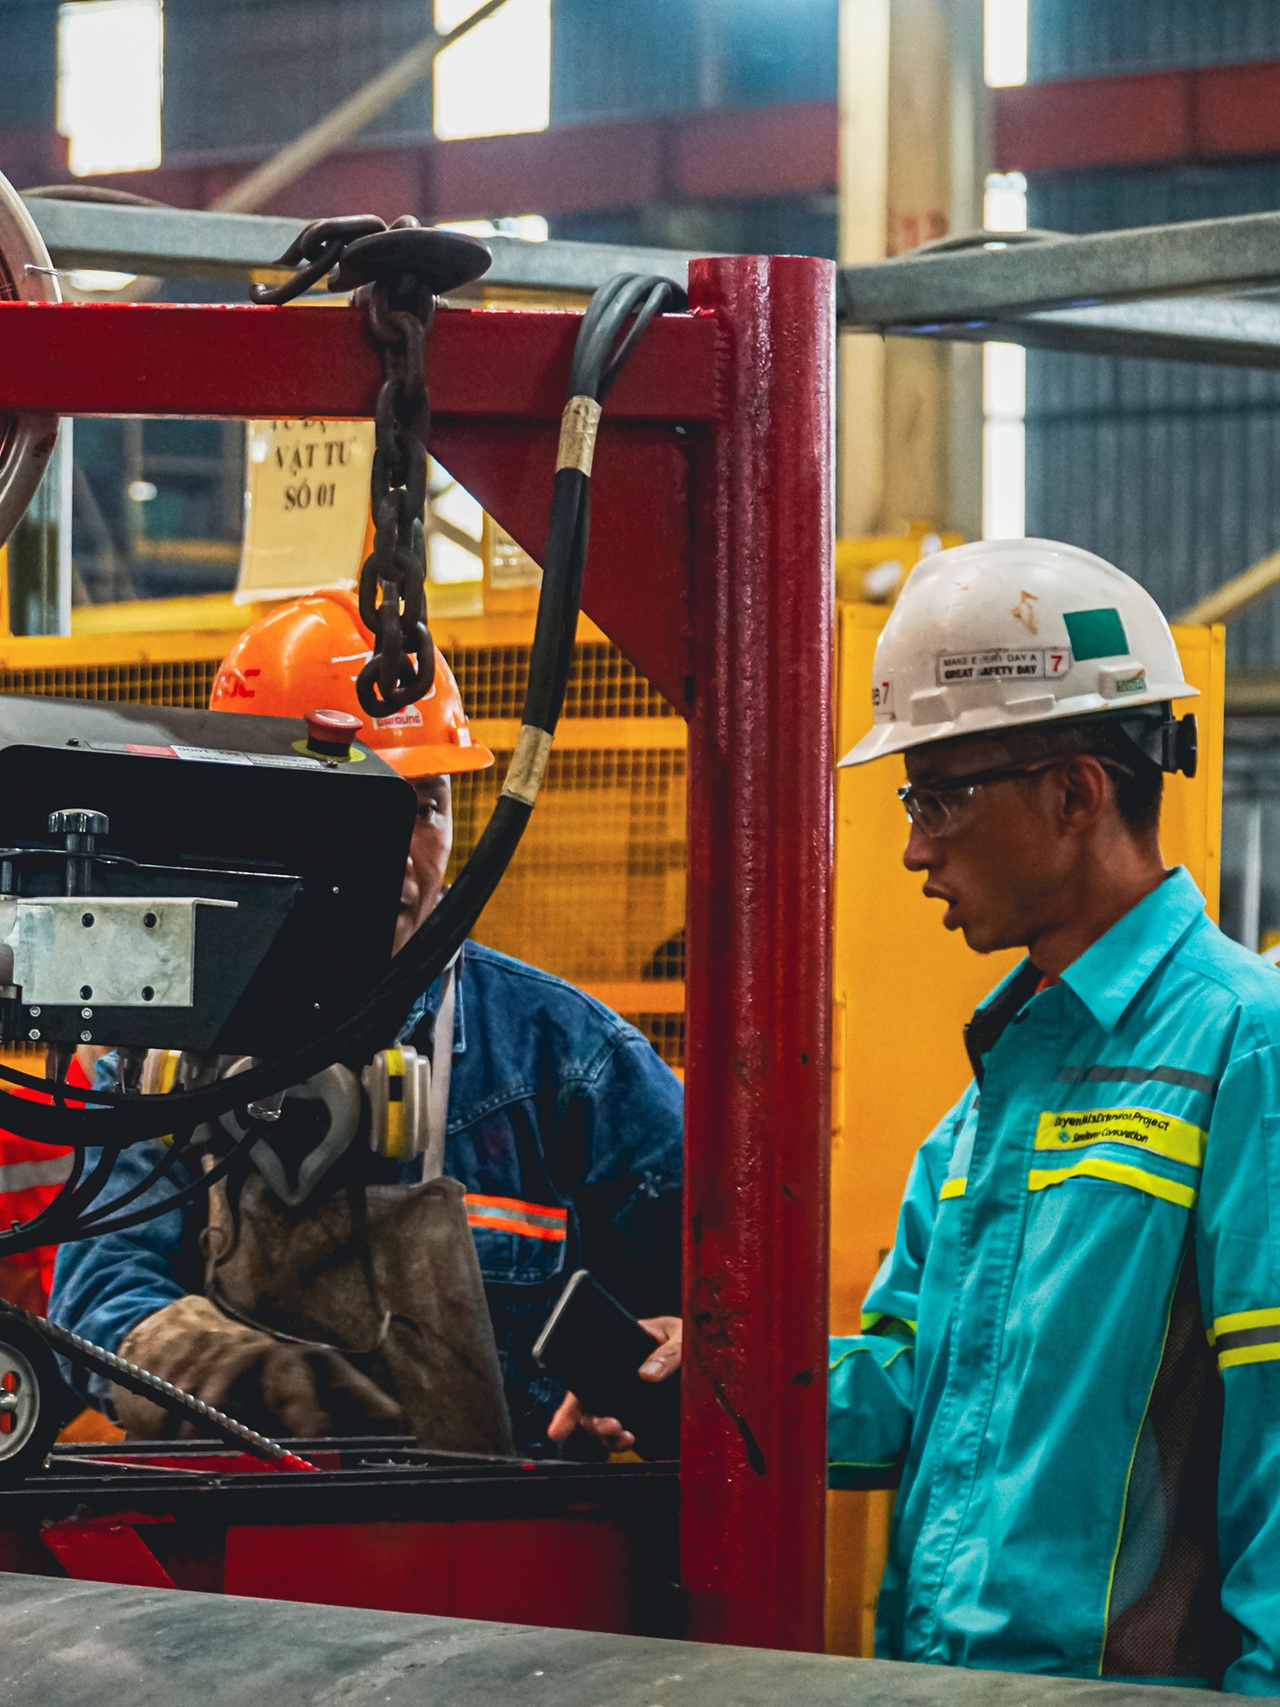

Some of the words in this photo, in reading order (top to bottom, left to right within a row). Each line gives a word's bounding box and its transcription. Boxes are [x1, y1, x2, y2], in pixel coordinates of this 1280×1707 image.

[317, 482, 336, 507] 01
[1007, 653, 1028, 664] DAY
[1030, 654, 1037, 662] A
[1050, 655, 1064, 673] 7
[944, 668, 974, 680] GREAT
[1016, 665, 1037, 676] DAY
[1132, 1112, 1170, 1131] Project
